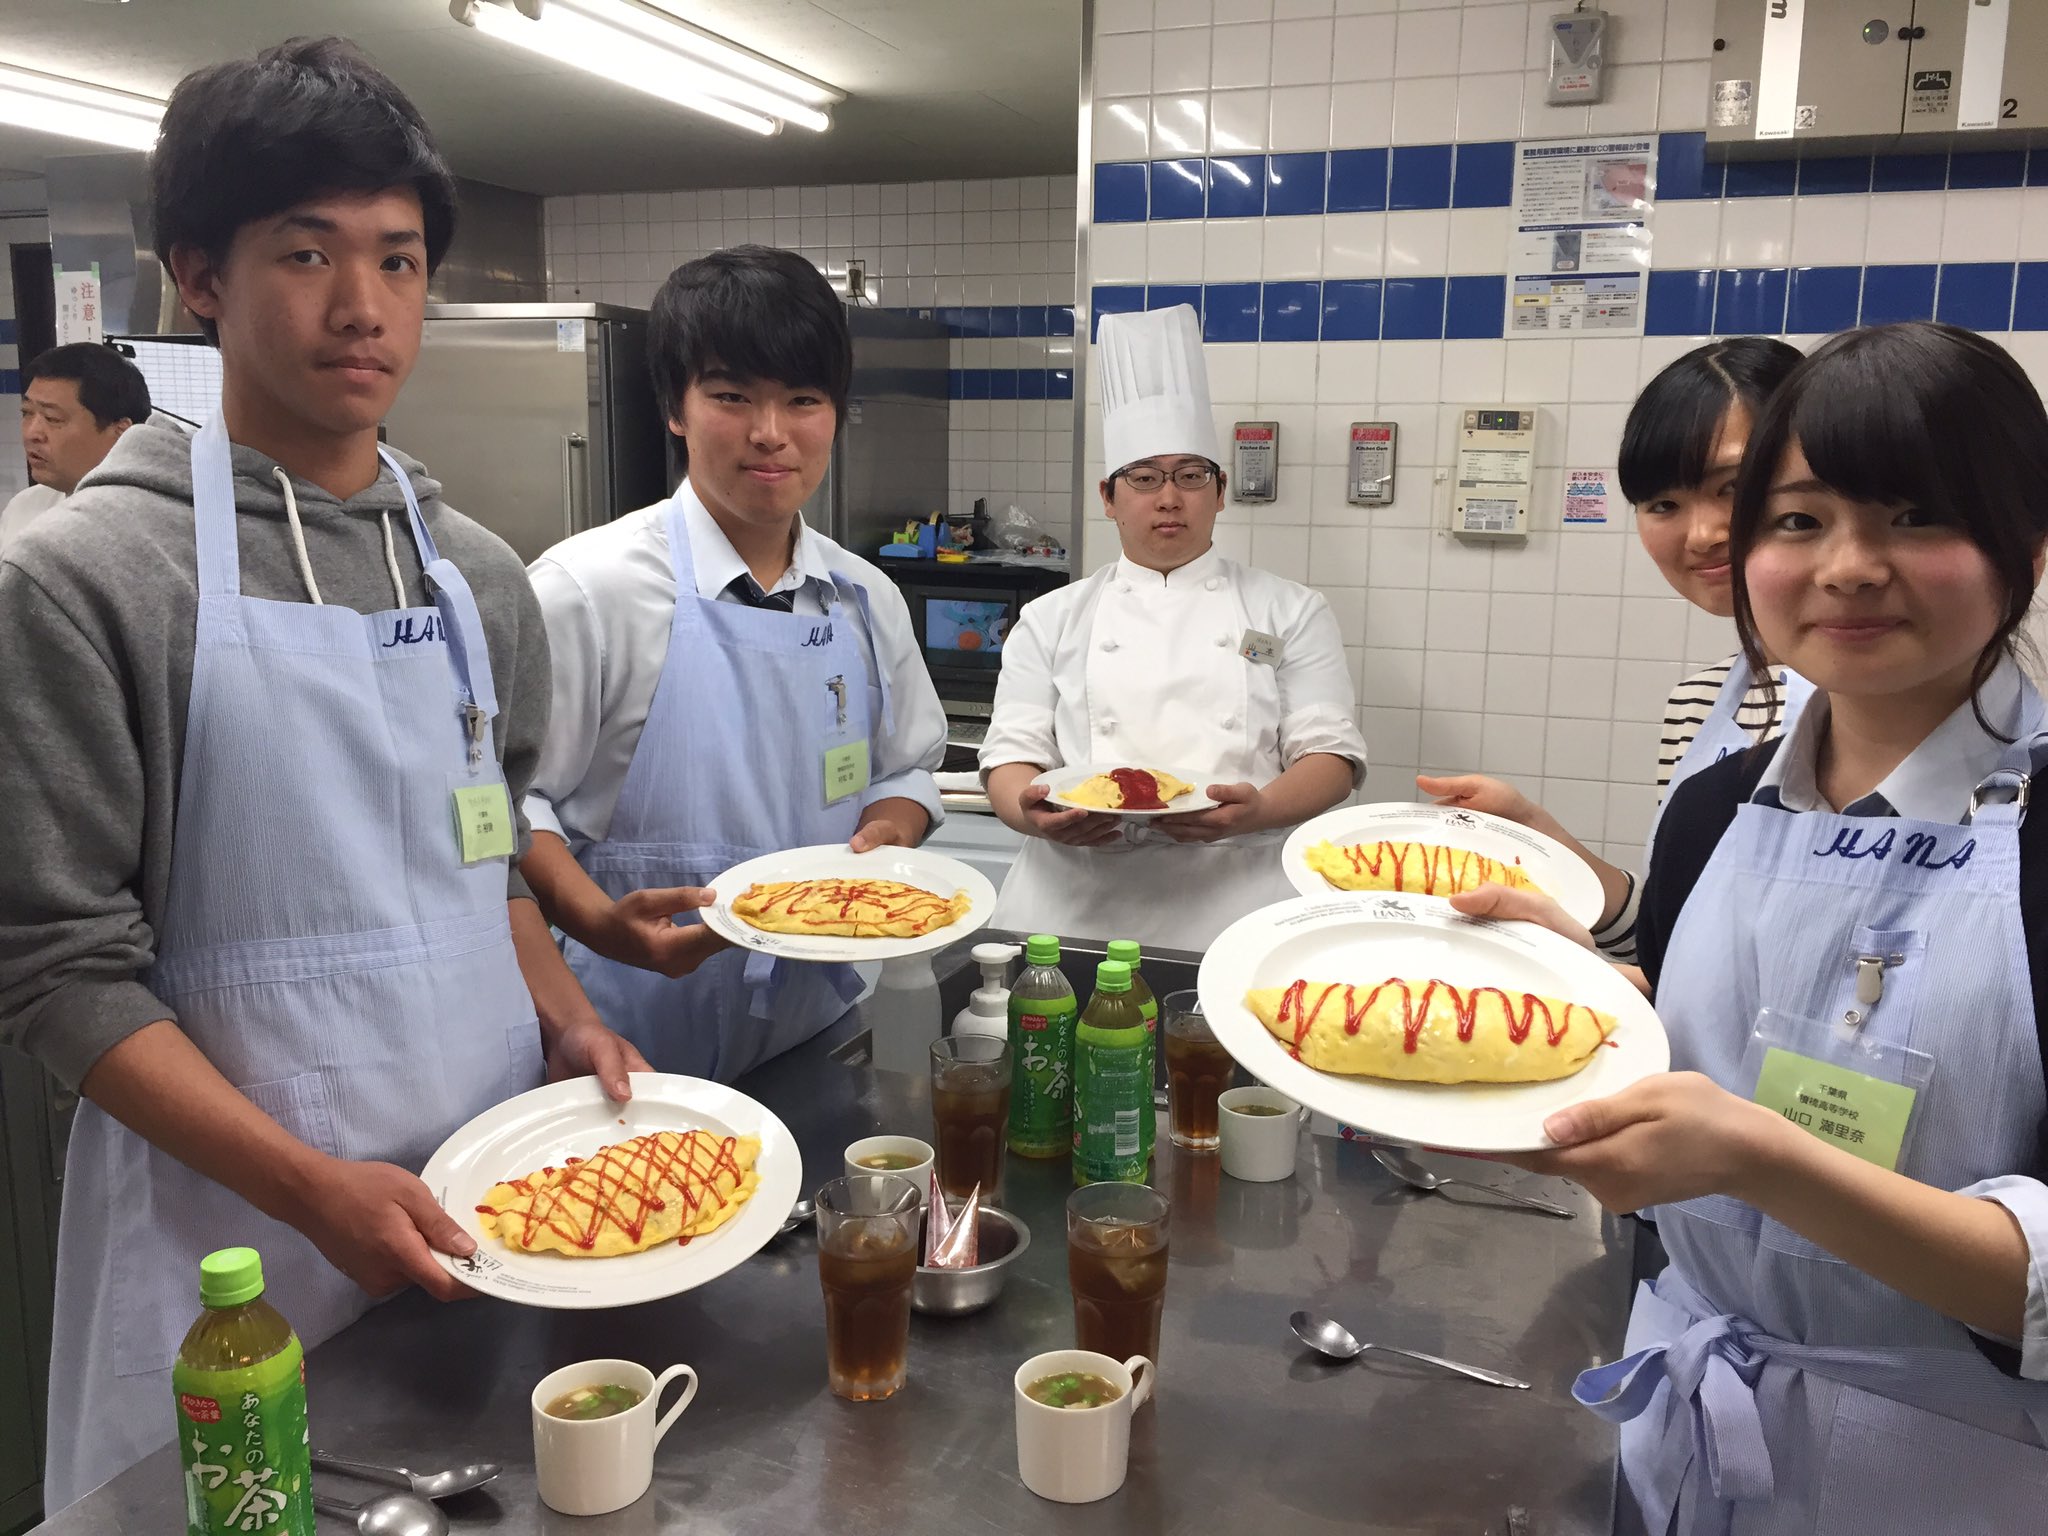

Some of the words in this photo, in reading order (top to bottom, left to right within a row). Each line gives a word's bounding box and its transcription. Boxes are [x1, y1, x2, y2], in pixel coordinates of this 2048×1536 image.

[1798, 107, 1813, 127] 2
[2002, 98, 2018, 119] 2
[1813, 827, 1977, 870] HANA
[1372, 909, 1417, 921] HANA
[1783, 1107, 1812, 1126] 山口
[1818, 1118, 1866, 1144] 満里奈
[241, 1393, 263, 1464] あなたの
[192, 1428, 287, 1531] お茶
